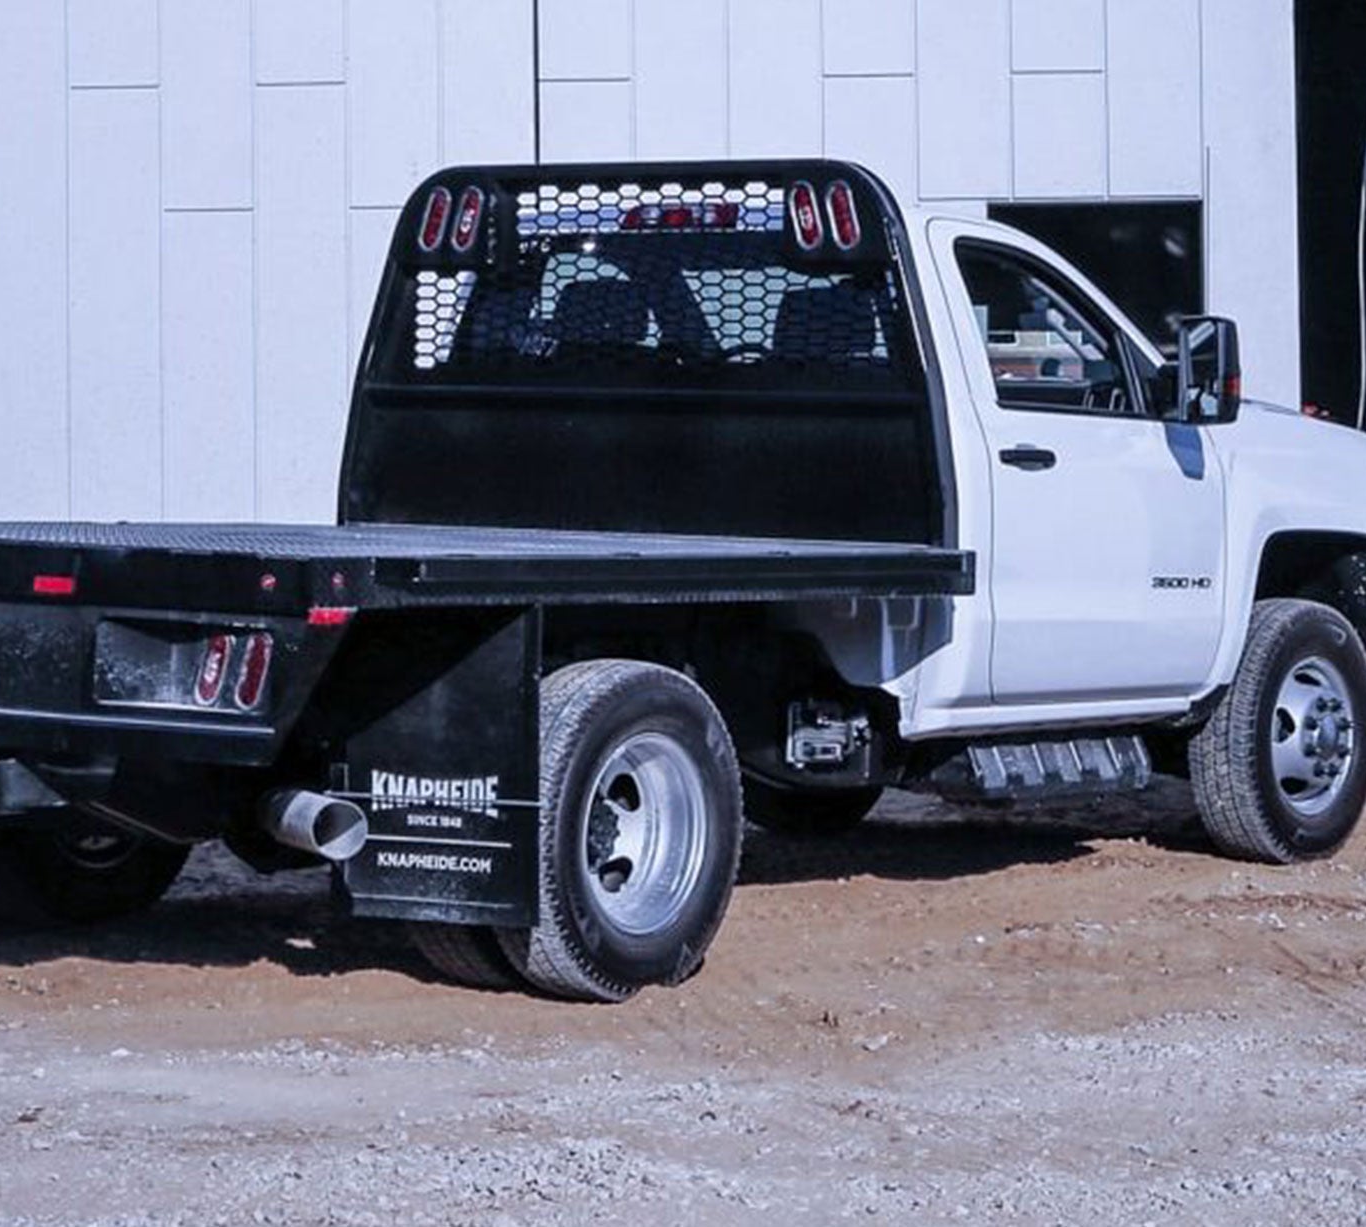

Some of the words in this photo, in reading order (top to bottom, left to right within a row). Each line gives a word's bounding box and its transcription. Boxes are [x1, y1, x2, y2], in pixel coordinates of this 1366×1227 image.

[1152, 577, 1189, 589] 3500
[1191, 577, 1212, 589] HD
[372, 769, 498, 819] KNAPHEIDE
[407, 814, 437, 827] SINCE
[378, 852, 492, 873] KNAPHEIDE.COM
